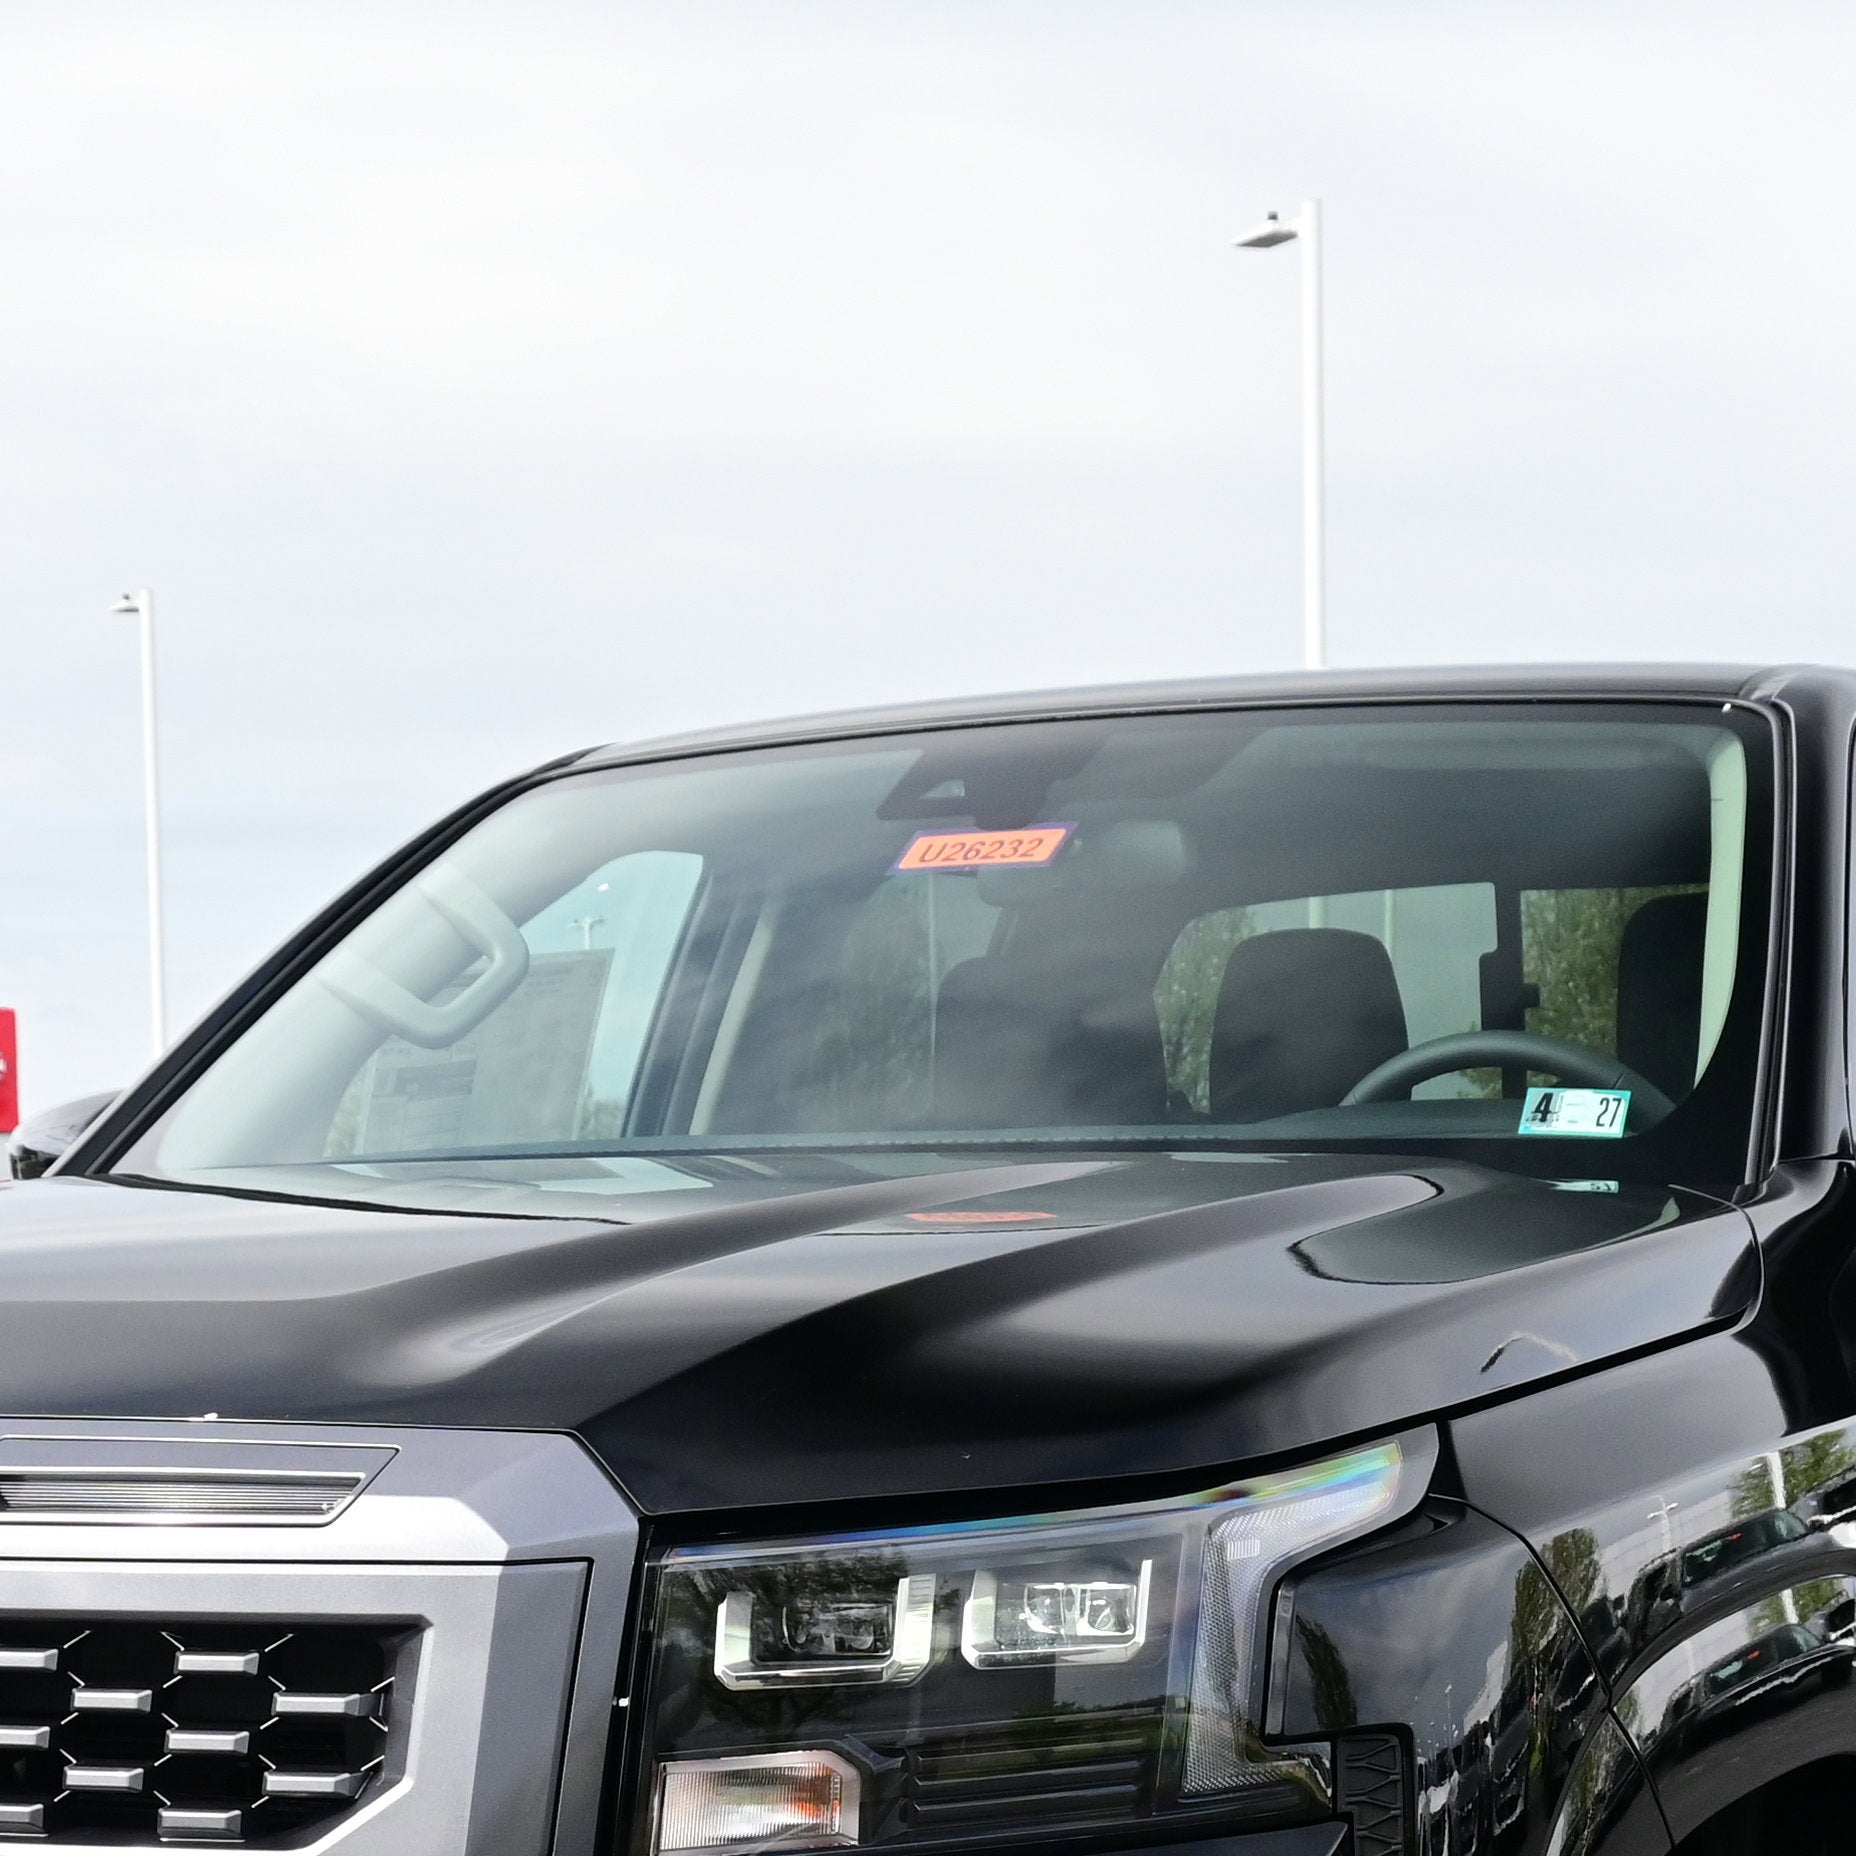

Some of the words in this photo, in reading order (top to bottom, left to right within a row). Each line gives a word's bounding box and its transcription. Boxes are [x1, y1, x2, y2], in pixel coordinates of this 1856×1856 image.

[919, 837, 1044, 863] U26232
[1533, 1092, 1553, 1122] 4
[1595, 1097, 1623, 1128] 27
